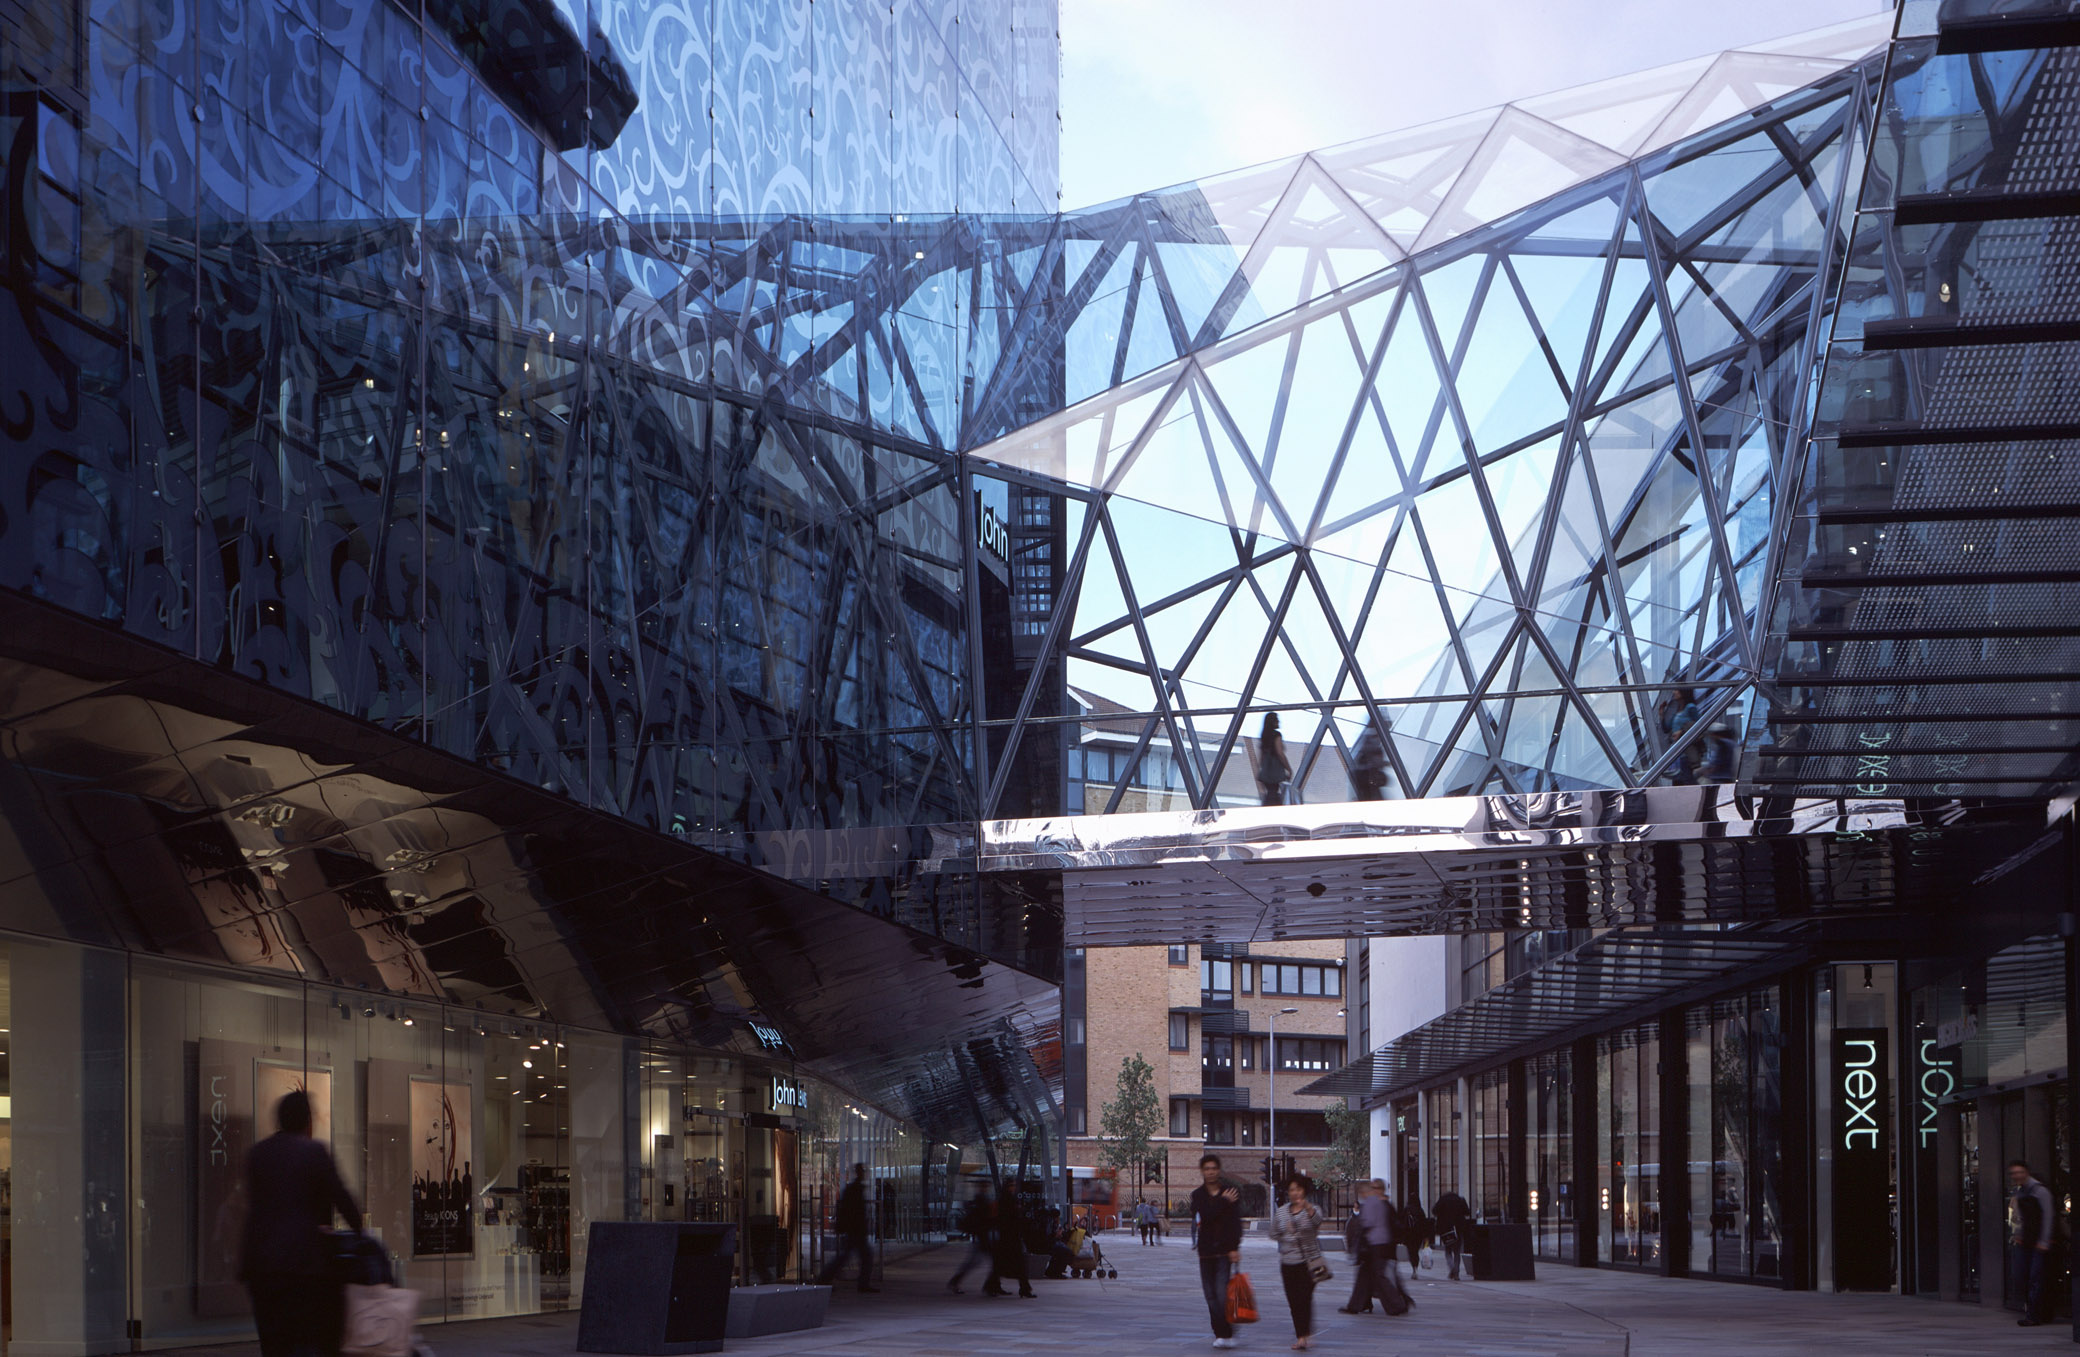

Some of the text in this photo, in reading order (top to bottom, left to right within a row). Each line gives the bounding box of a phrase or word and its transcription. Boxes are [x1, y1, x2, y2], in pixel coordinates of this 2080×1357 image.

[979, 489, 1009, 562] John
[772, 1076, 796, 1111] John
[1845, 1040, 1879, 1150] next
